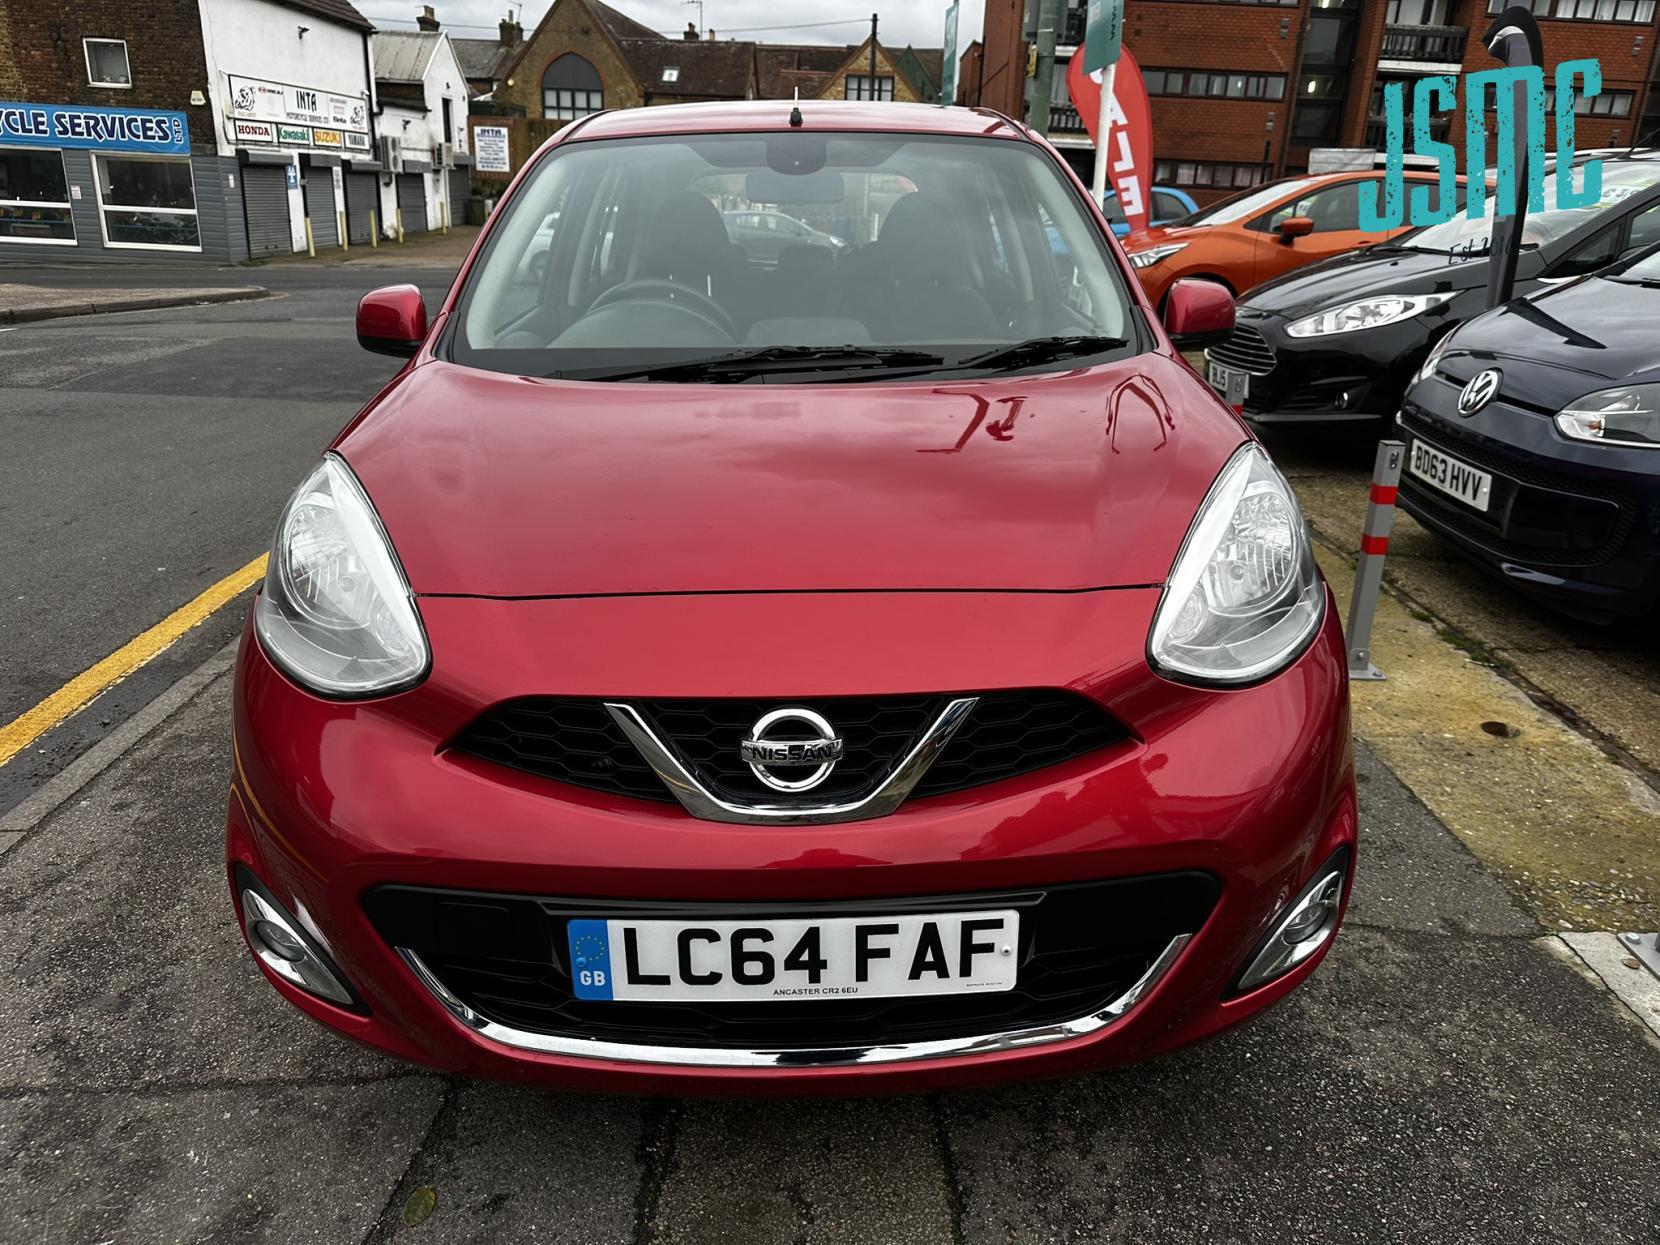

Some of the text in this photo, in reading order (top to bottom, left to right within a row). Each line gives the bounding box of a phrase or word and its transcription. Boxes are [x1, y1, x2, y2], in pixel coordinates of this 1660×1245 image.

[296, 90, 317, 112] INTA
[54, 111, 172, 143] SERVICES
[172, 119, 184, 144] LTD
[238, 125, 270, 136] HONDA
[279, 127, 309, 142] Kawasaki
[314, 130, 341, 144] SUZUKI
[1414, 444, 1482, 501] BD63 HVV
[752, 744, 833, 761] NISSAN
[623, 918, 1005, 986] LC64 FAF
[580, 970, 606, 986] GB
[773, 988, 820, 996] ANCASTER
[822, 987, 840, 995] CR2
